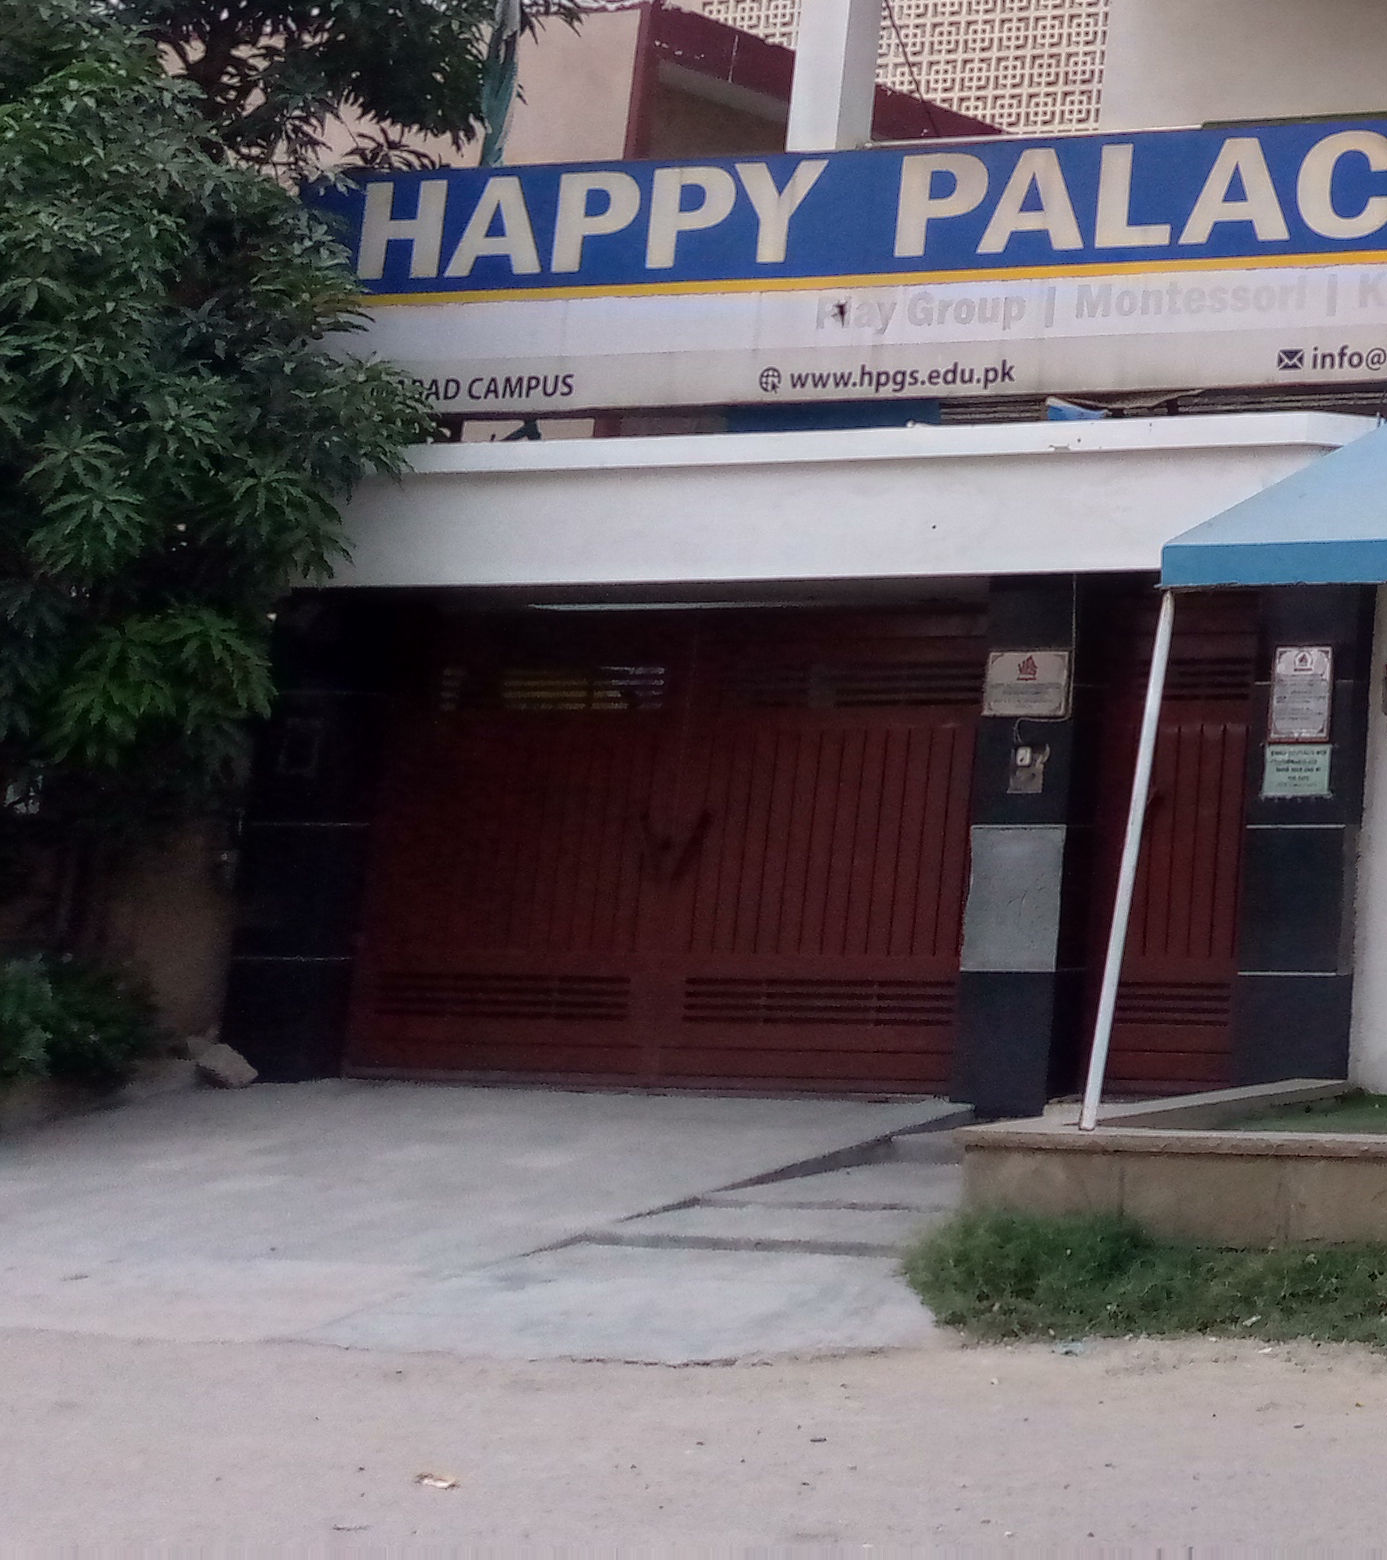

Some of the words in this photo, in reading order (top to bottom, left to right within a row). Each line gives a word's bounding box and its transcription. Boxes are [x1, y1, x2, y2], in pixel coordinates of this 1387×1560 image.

[356, 159, 829, 281] HAPPY
[908, 291, 1027, 331] Group
[1075, 275, 1306, 320] Montessori
[468, 373, 575, 400] CAMPUS
[788, 359, 1016, 393] www.hpgs.edu.pk
